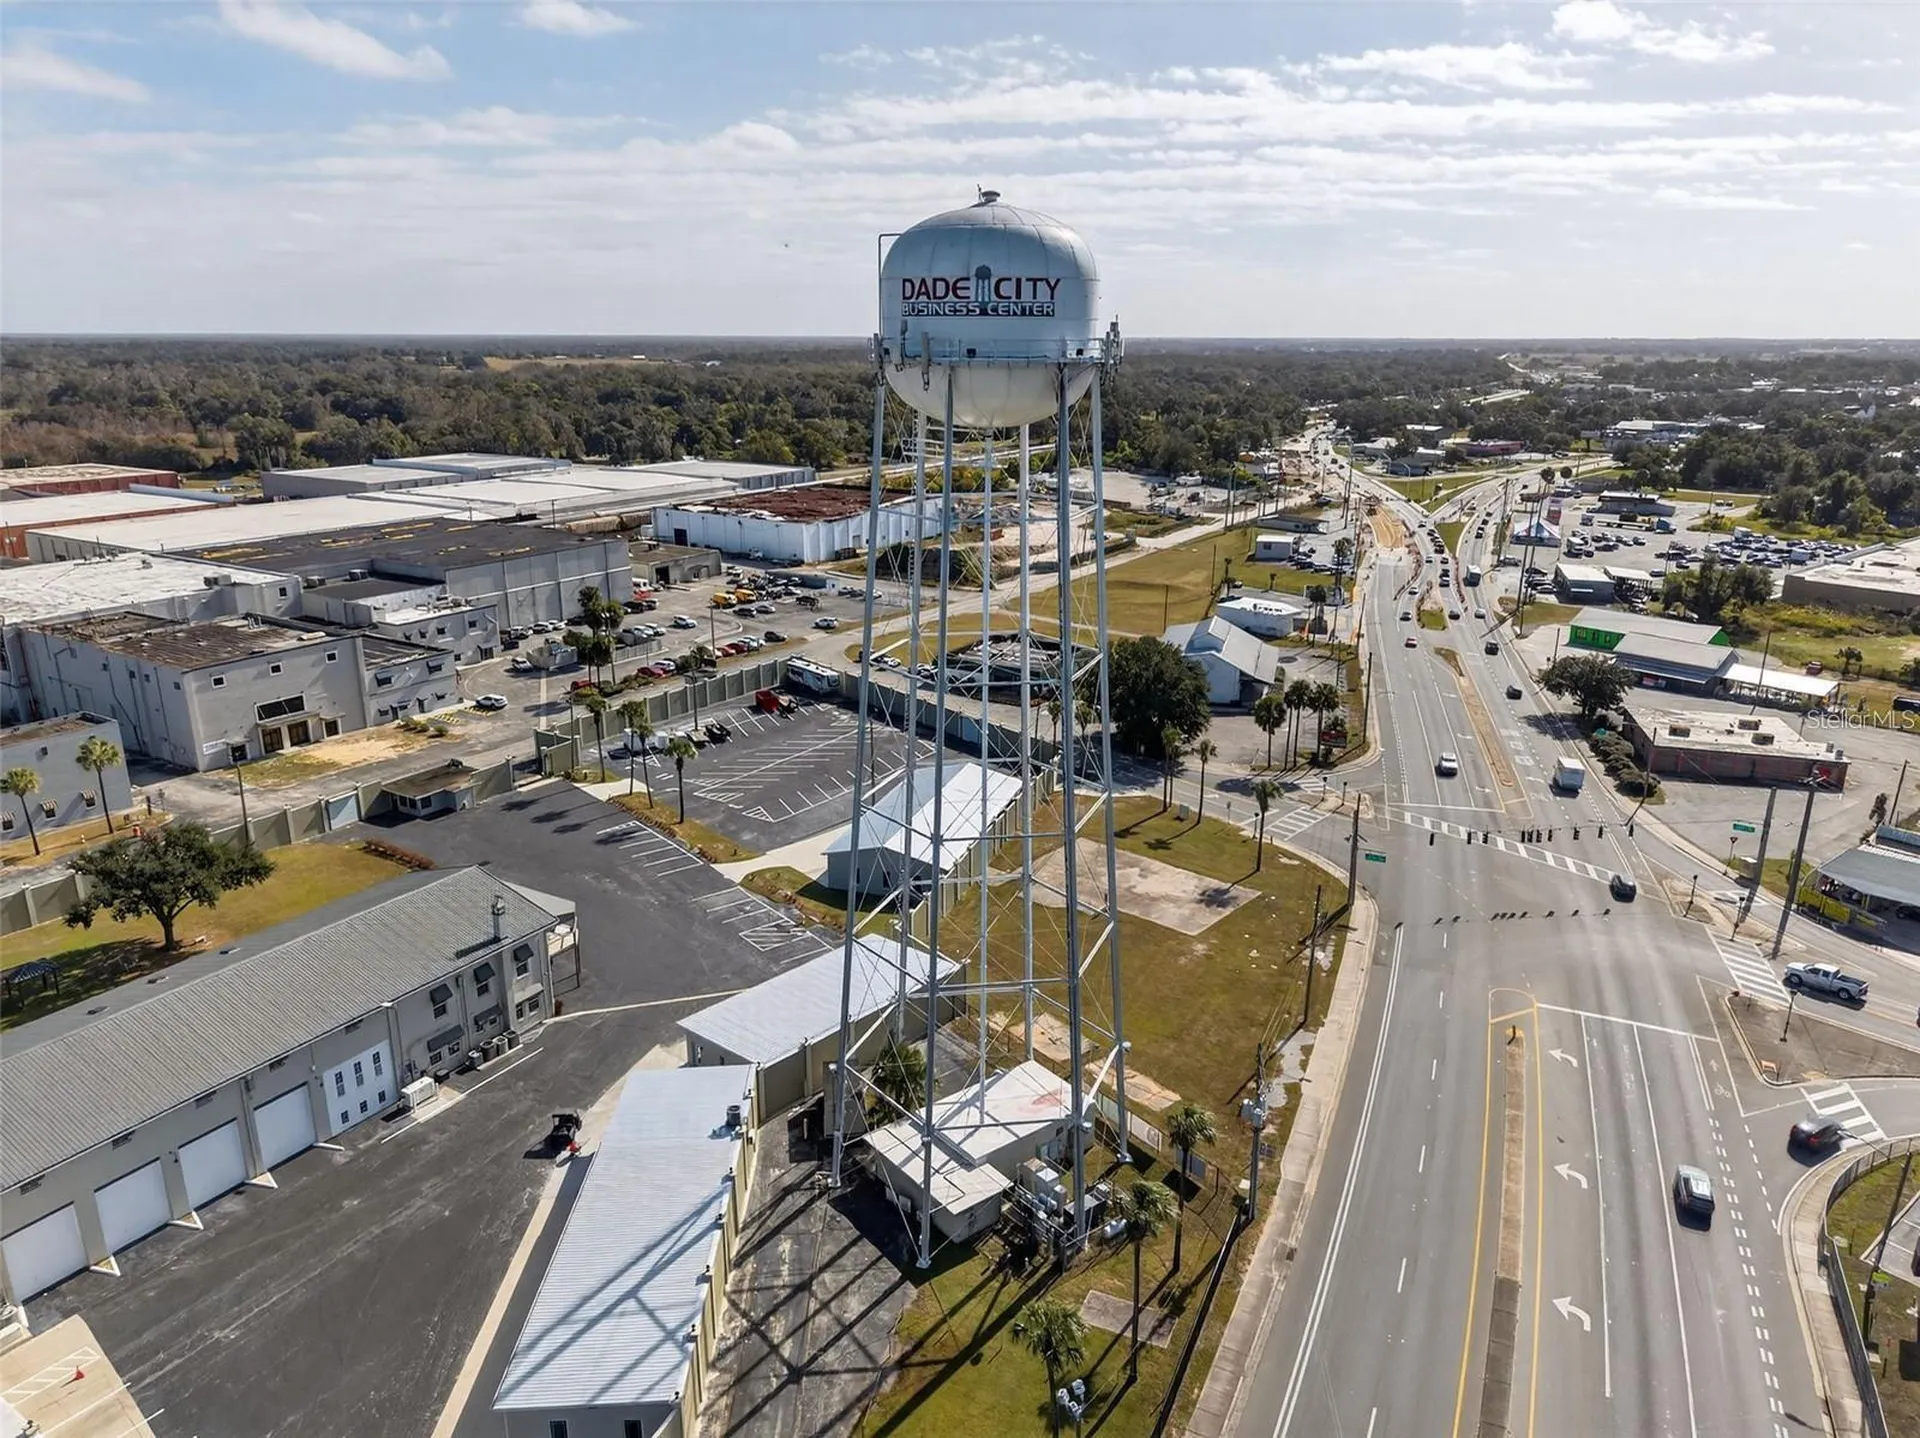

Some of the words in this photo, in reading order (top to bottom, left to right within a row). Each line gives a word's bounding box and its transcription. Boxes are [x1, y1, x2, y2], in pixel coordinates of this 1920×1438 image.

[902, 277, 971, 300] DADE
[993, 277, 1062, 300] CITY
[902, 302, 980, 316] BUSINESS
[986, 302, 1054, 316] CENTER
